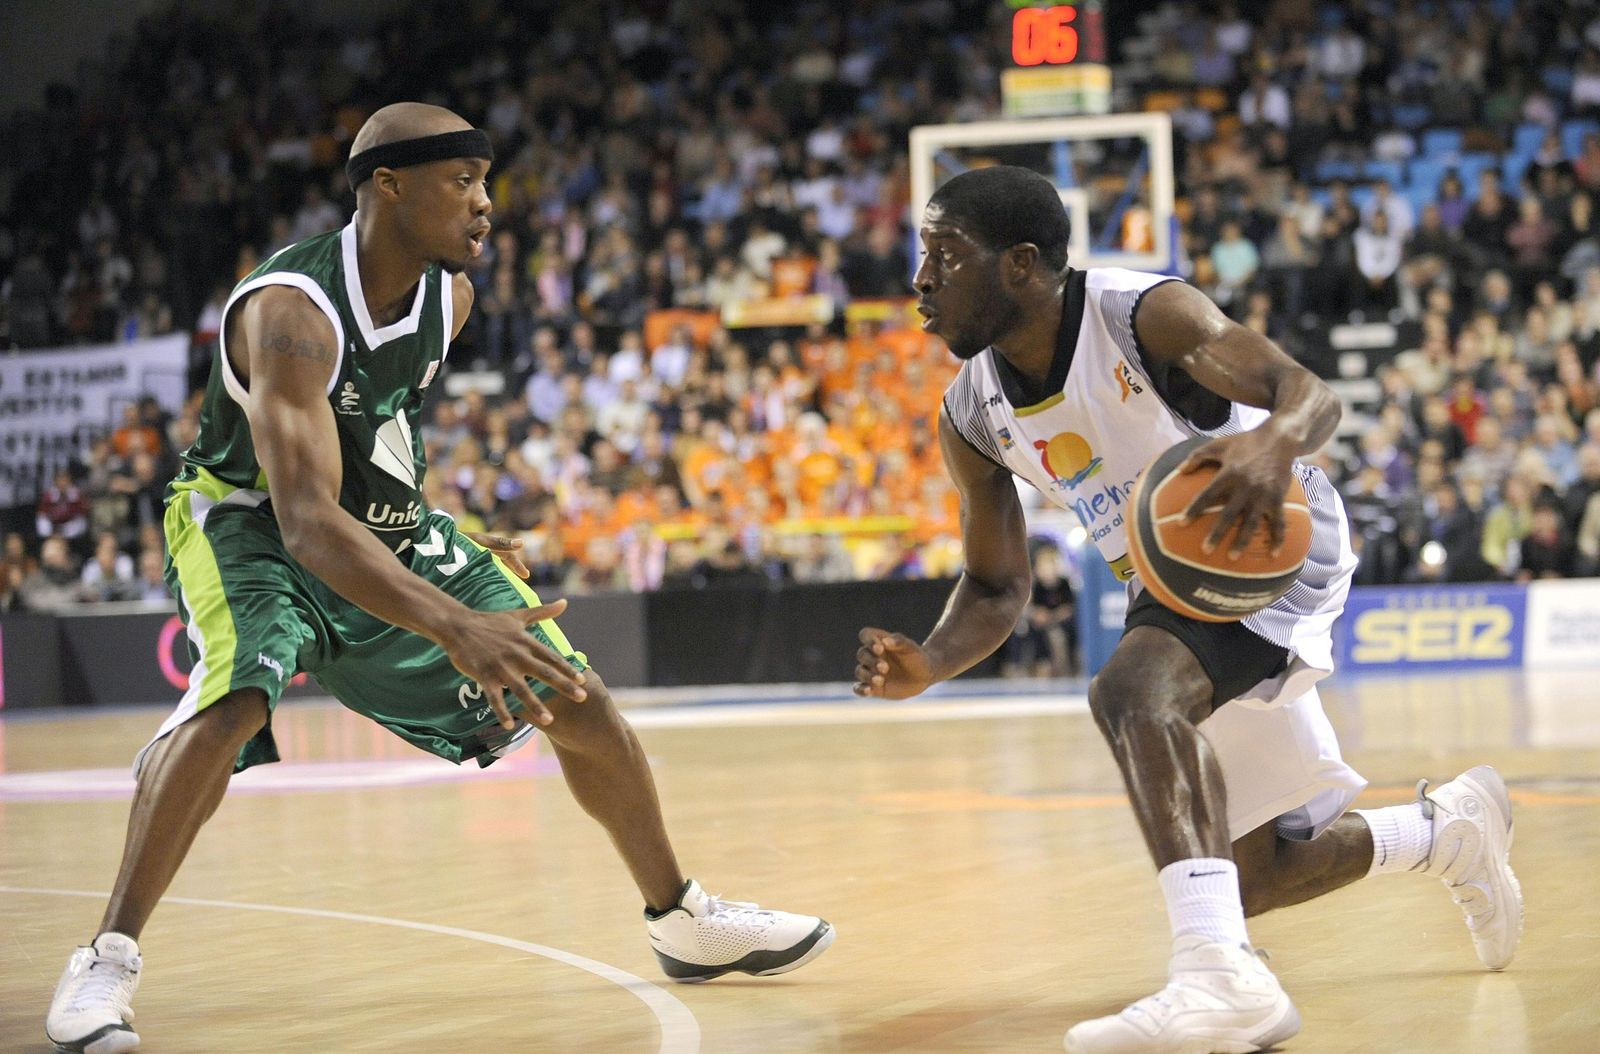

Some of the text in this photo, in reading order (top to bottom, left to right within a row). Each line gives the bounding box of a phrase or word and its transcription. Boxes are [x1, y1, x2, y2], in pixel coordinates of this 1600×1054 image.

[1011, 4, 1078, 67] 06
[1123, 366, 1143, 394] ACB
[1351, 604, 1512, 664] SER
